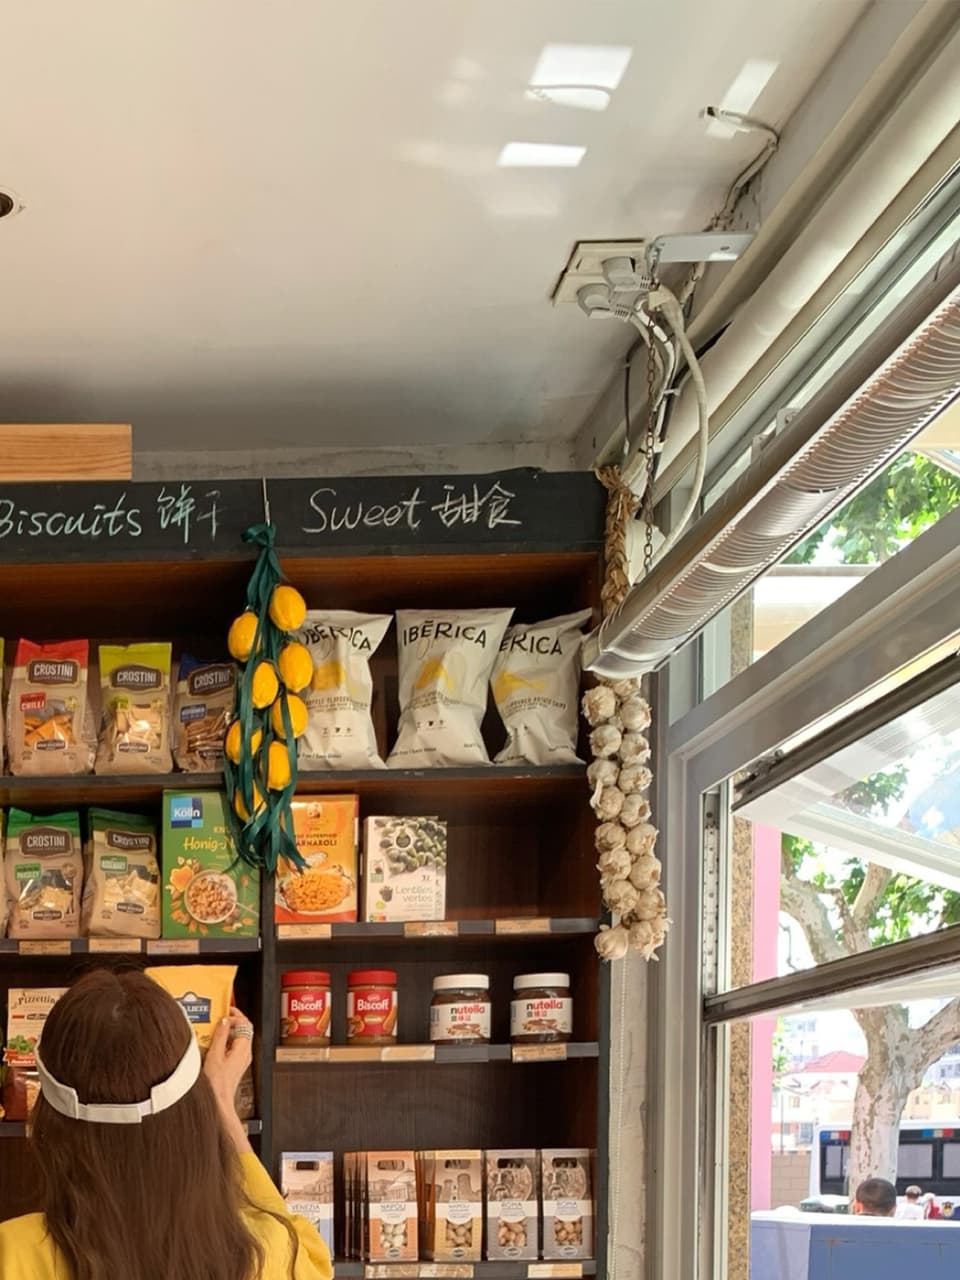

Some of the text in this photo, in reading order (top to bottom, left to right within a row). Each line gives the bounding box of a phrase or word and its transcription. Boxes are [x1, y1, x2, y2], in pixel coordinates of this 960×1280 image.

[302, 487, 422, 533] Sweet
[33, 663, 74, 677] CROSTINI
[116, 671, 157, 683] CROSTINI
[174, 807, 201, 818] Kölln
[27, 835, 65, 847] CROSTINI
[290, 1000, 323, 1011] Biscoff
[357, 1000, 389, 1011] Biscoff
[450, 1004, 485, 1015] nutella
[526, 998, 563, 1010] nutella
